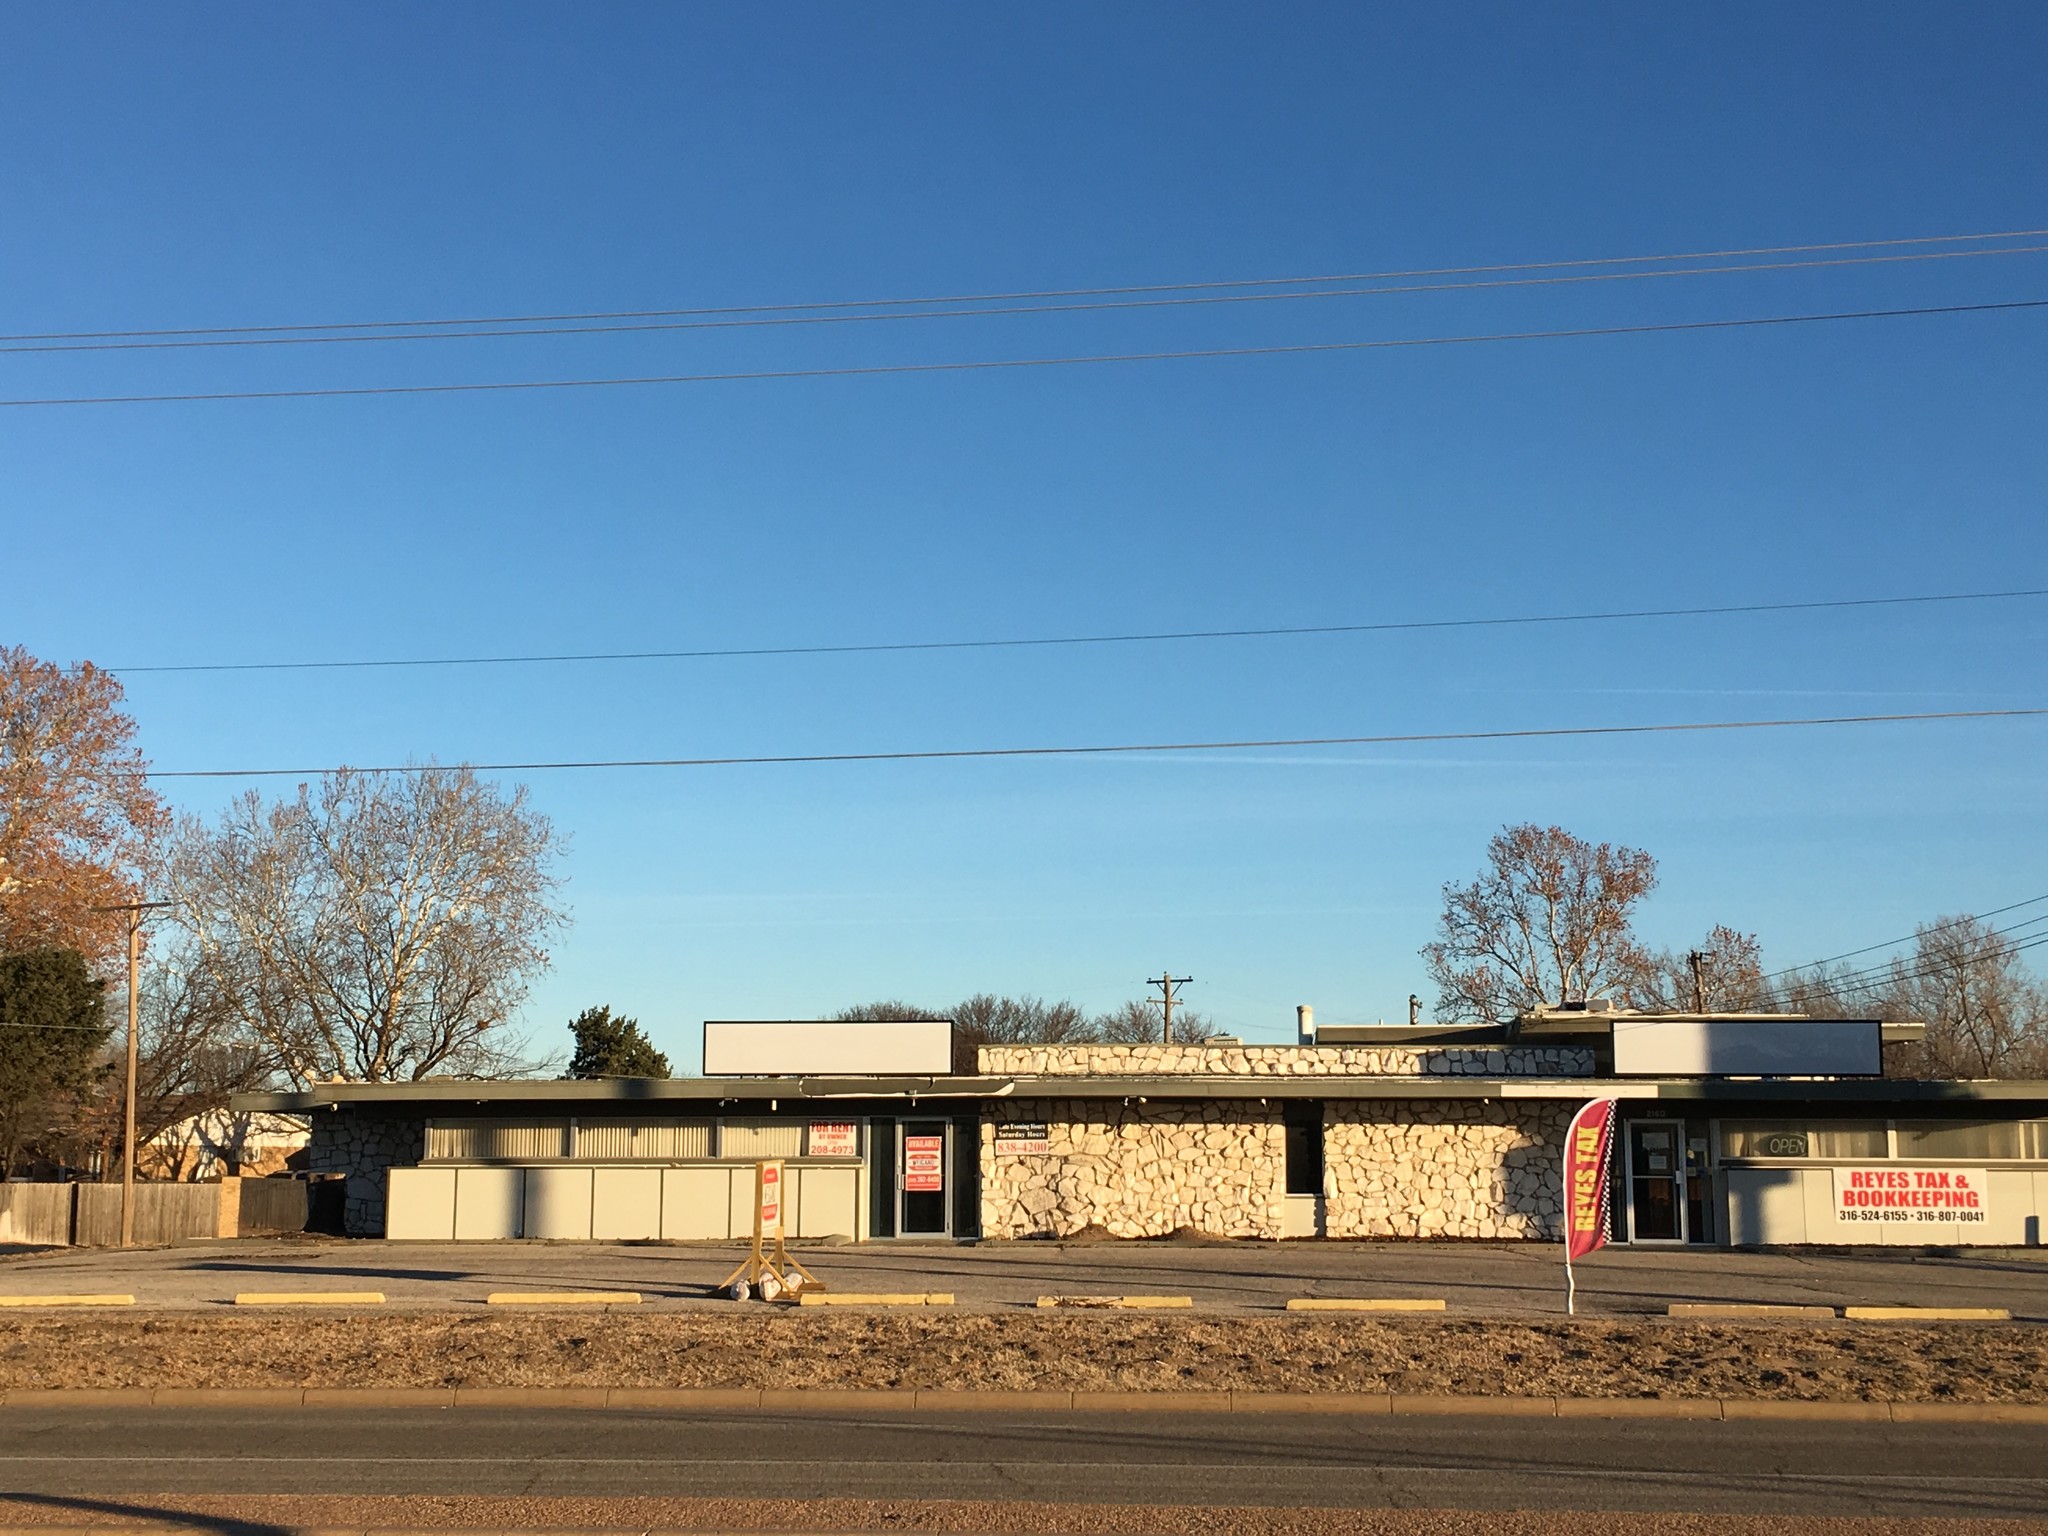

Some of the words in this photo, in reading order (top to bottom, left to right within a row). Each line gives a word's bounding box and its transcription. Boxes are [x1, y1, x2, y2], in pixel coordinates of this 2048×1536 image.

[811, 1121, 829, 1132] FOR
[831, 1121, 854, 1132] RENT
[811, 1145, 855, 1154] 208-4973
[908, 1139, 939, 1149] AVAILABLE
[997, 1142, 1047, 1153] 838-4200
[1575, 1126, 1600, 1165] TAX
[1770, 1138, 1807, 1154] OPEN
[1851, 1171, 1910, 1188] REYES
[1913, 1172, 1950, 1188] TAX
[1955, 1175, 1970, 1189] &
[1574, 1168, 1597, 1232] REYES
[1843, 1190, 1979, 1208] BOOKKEEPING
[1839, 1210, 1908, 1221] 316-524-6155
[1916, 1211, 1985, 1222] 316-807-0041
